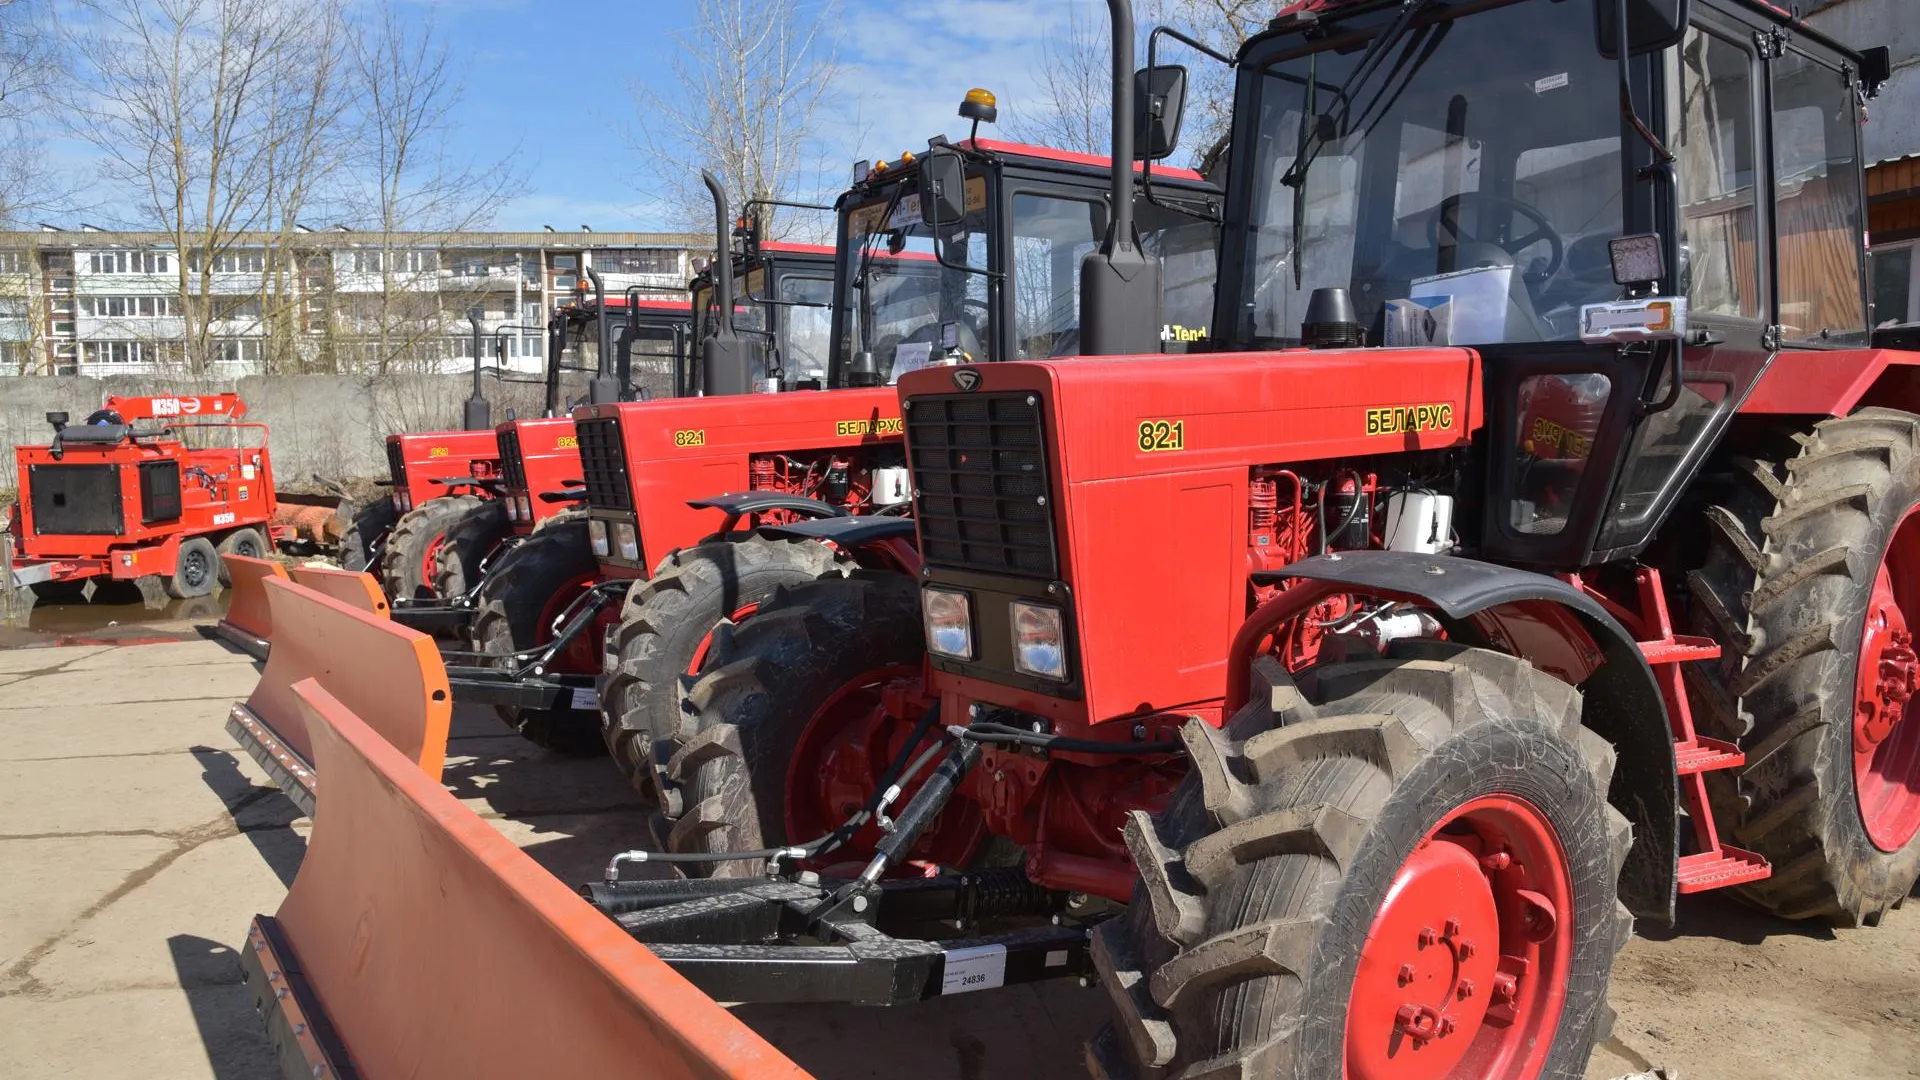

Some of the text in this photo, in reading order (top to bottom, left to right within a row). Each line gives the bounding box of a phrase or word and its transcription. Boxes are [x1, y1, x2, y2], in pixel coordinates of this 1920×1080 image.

[151, 398, 180, 415] M350
[1366, 404, 1452, 436] БЕЛАРУС
[675, 430, 704, 447] 82.1
[1138, 420, 1183, 452] 82.1
[213, 512, 235, 525] M350
